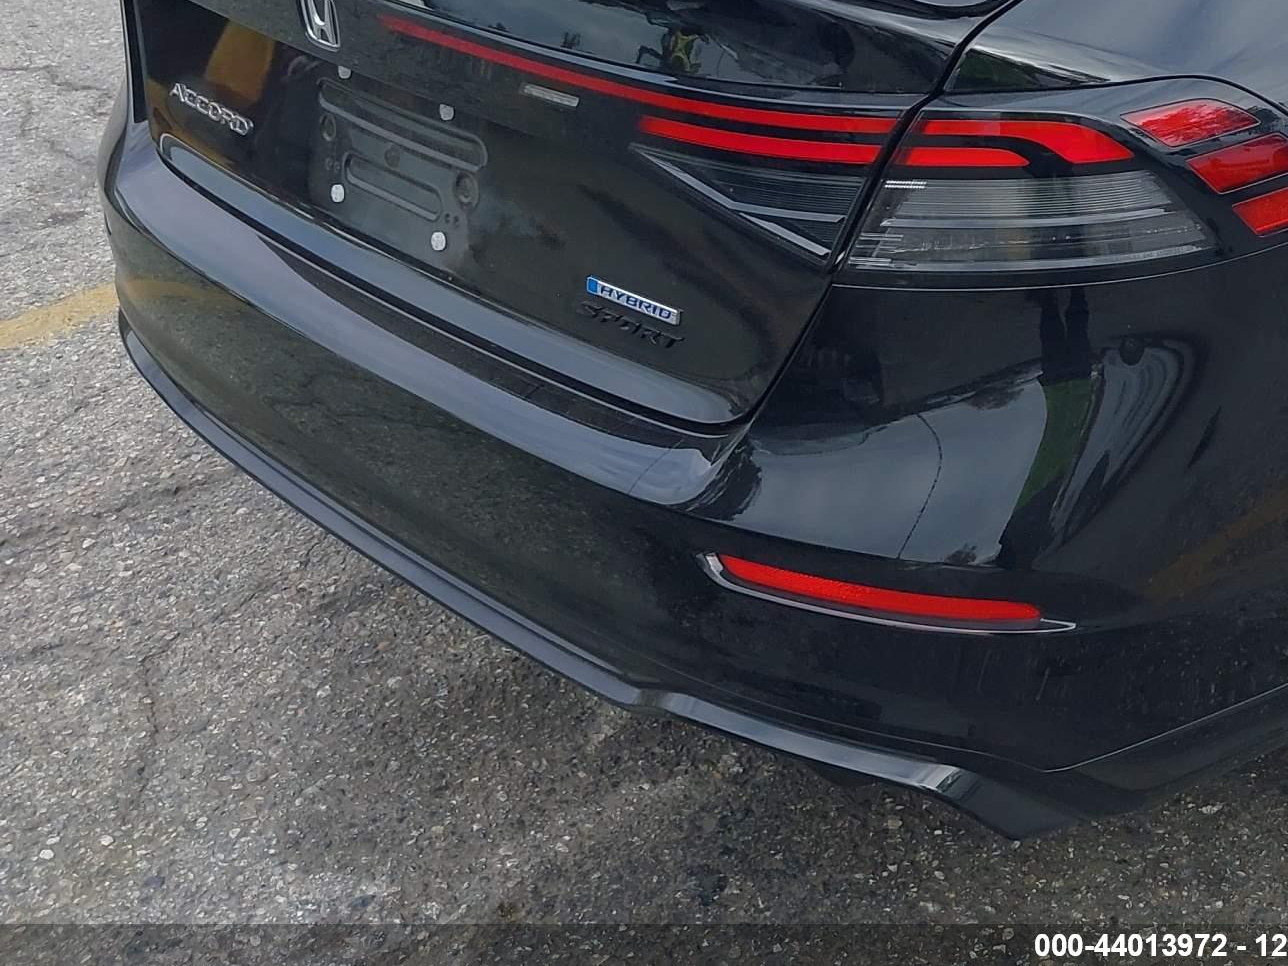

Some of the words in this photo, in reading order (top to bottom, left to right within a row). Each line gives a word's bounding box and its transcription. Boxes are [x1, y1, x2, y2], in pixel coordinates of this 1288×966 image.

[169, 83, 254, 136] ACCORD
[577, 300, 685, 348] SPORT
[600, 284, 672, 320] HYBRID
